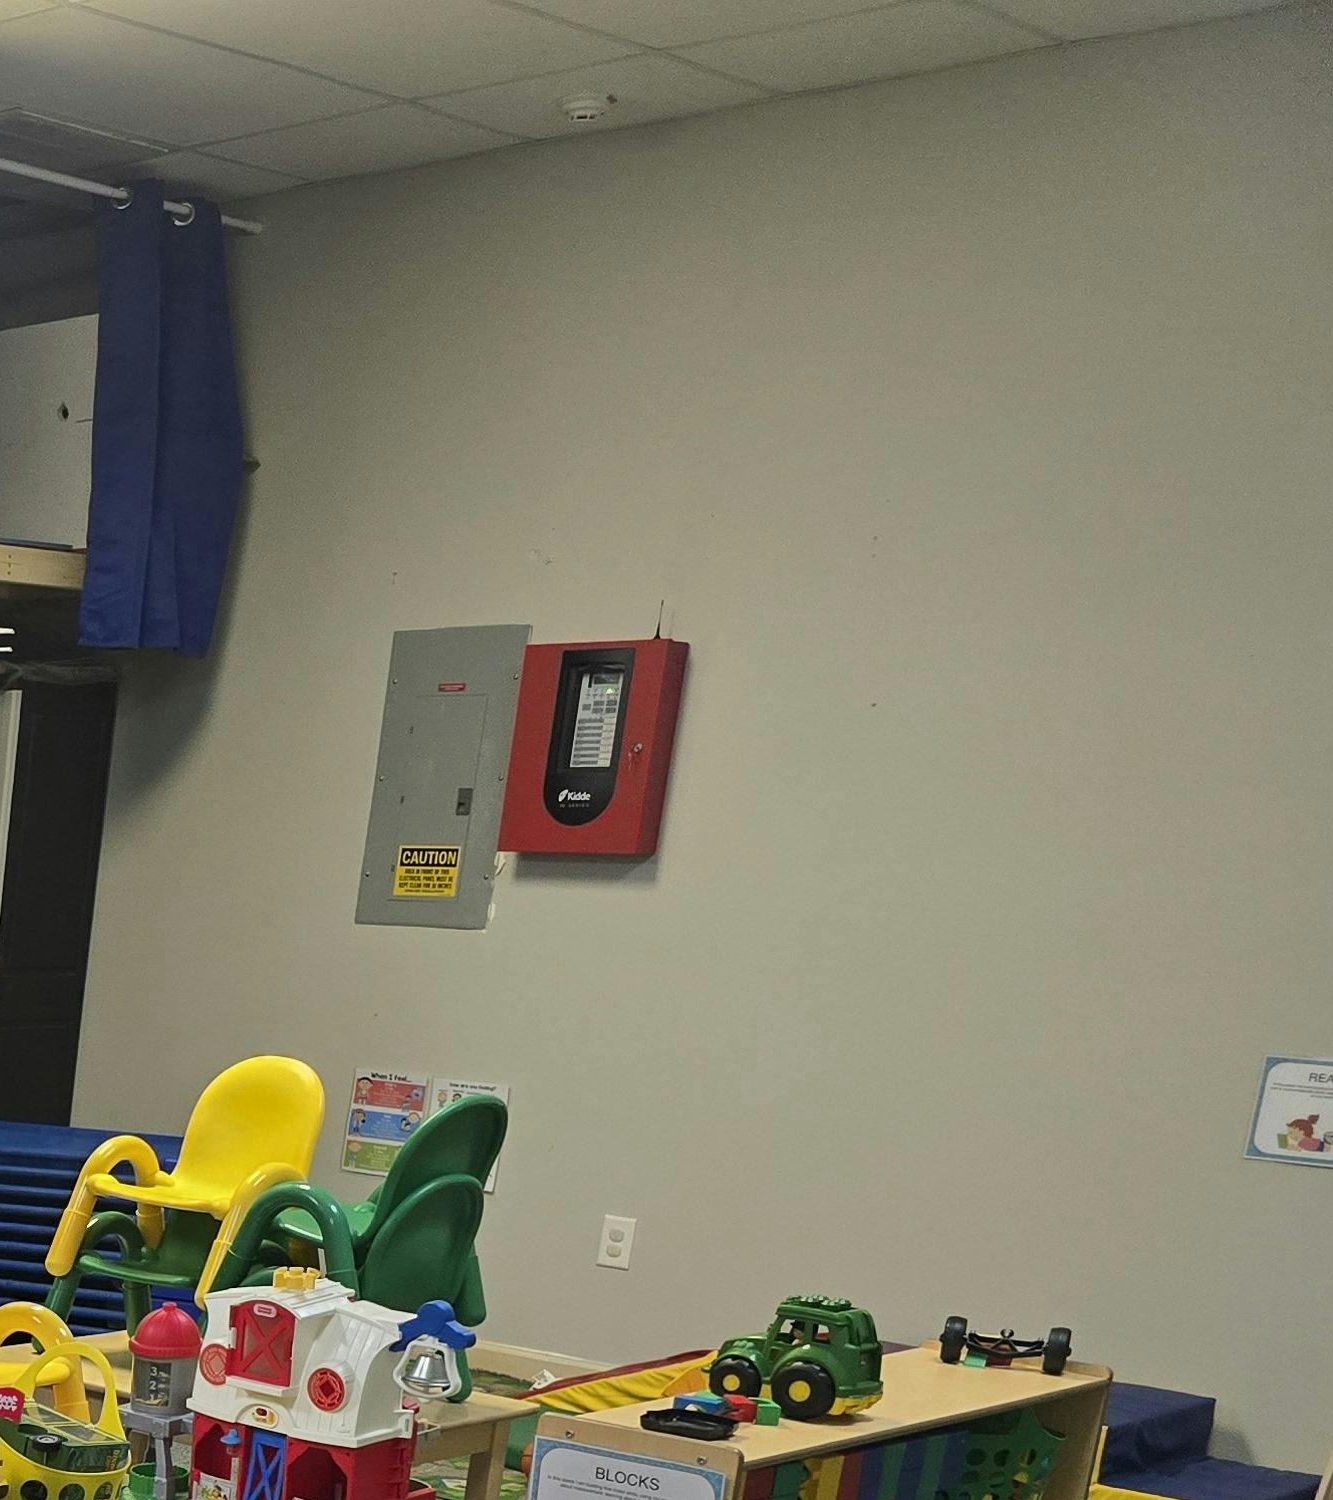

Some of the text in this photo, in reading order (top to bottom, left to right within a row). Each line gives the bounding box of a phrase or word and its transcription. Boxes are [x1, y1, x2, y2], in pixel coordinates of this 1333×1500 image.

[568, 791, 591, 801] Kidde
[402, 850, 457, 865] CAUTION
[370, 1071, 388, 1080] When
[150, 1366, 157, 1376] 3
[149, 1381, 156, 1390] 2
[595, 1466, 660, 1491] BLOCKS
